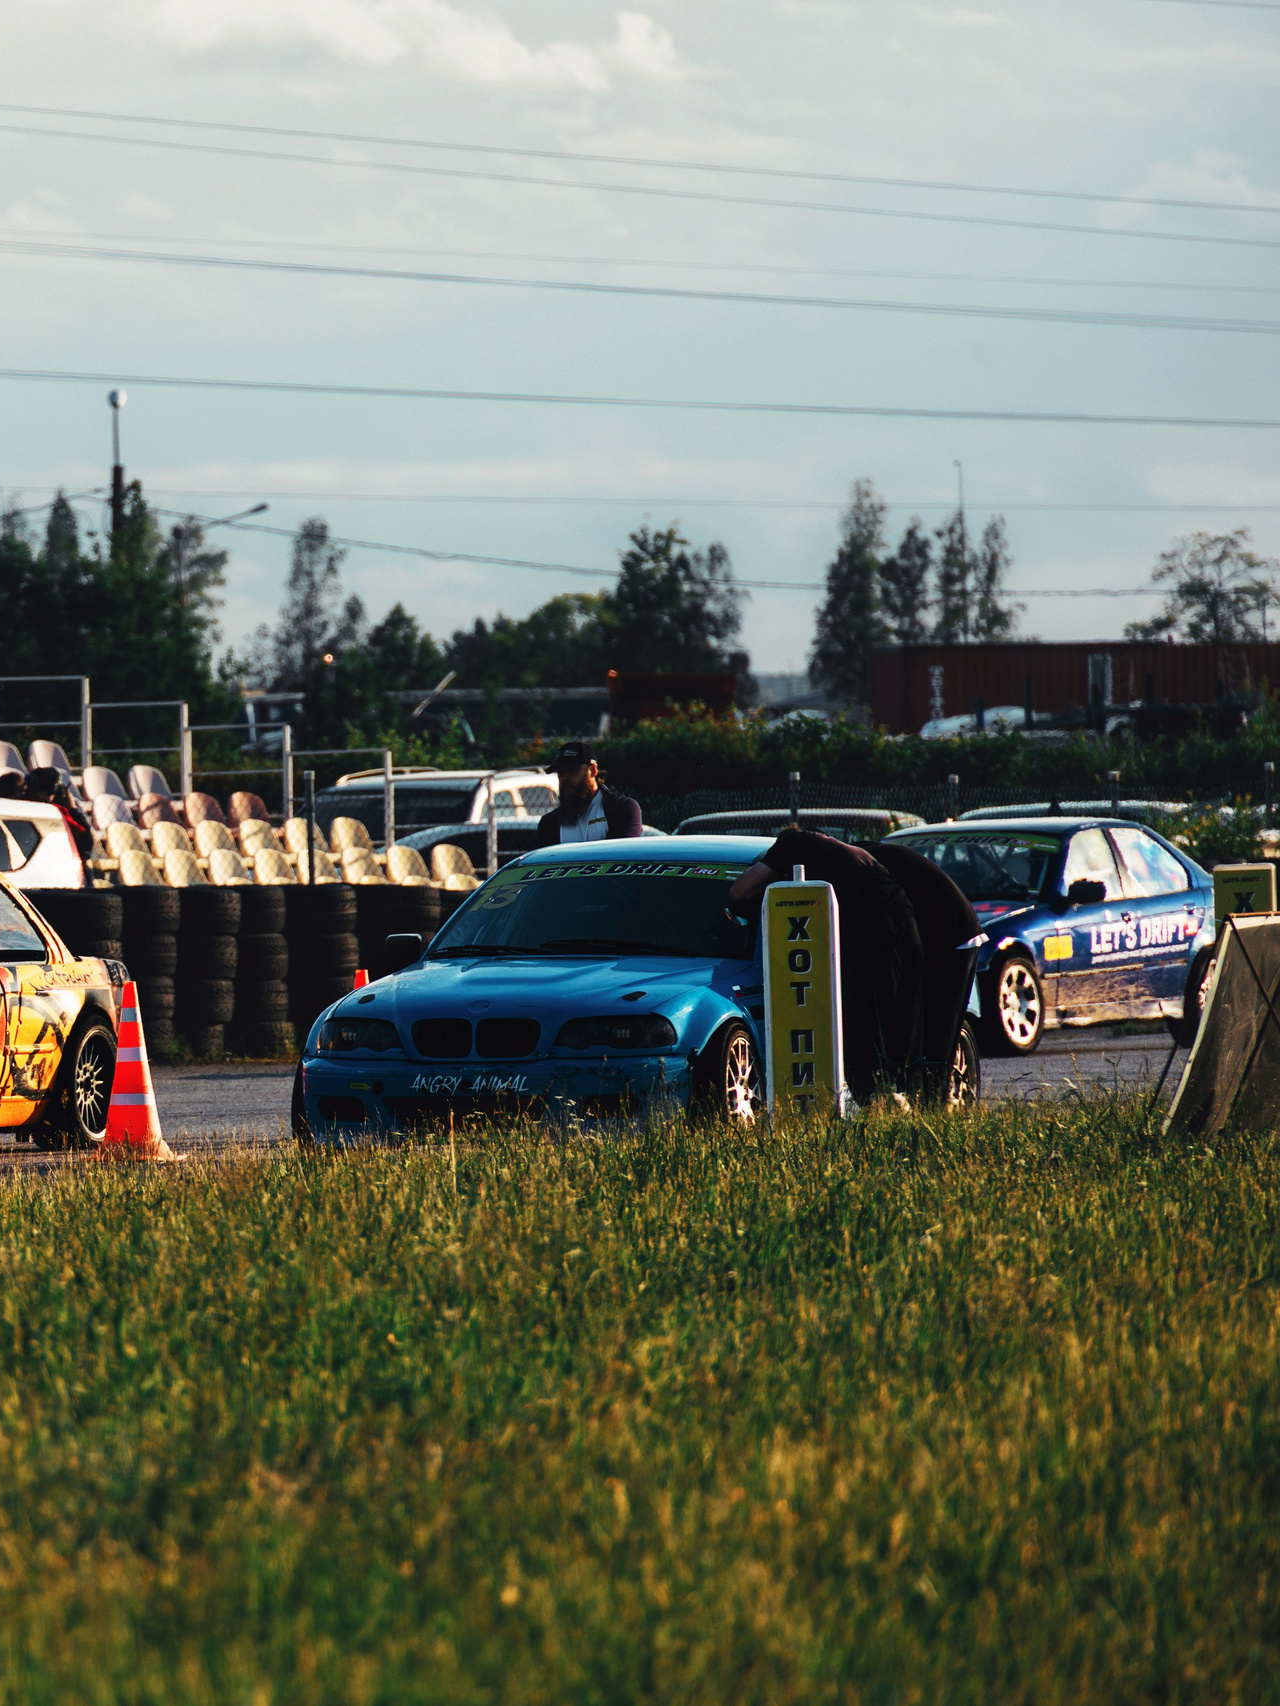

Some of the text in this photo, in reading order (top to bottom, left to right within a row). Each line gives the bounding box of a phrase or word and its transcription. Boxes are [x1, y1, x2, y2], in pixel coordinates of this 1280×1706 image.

[520, 864, 603, 882] LET'S
[470, 884, 528, 912] 13
[1090, 920, 1138, 955] LET'S
[787, 916, 813, 1007] ХОТ
[409, 1074, 529, 1096] ANGRY ANIMAL
